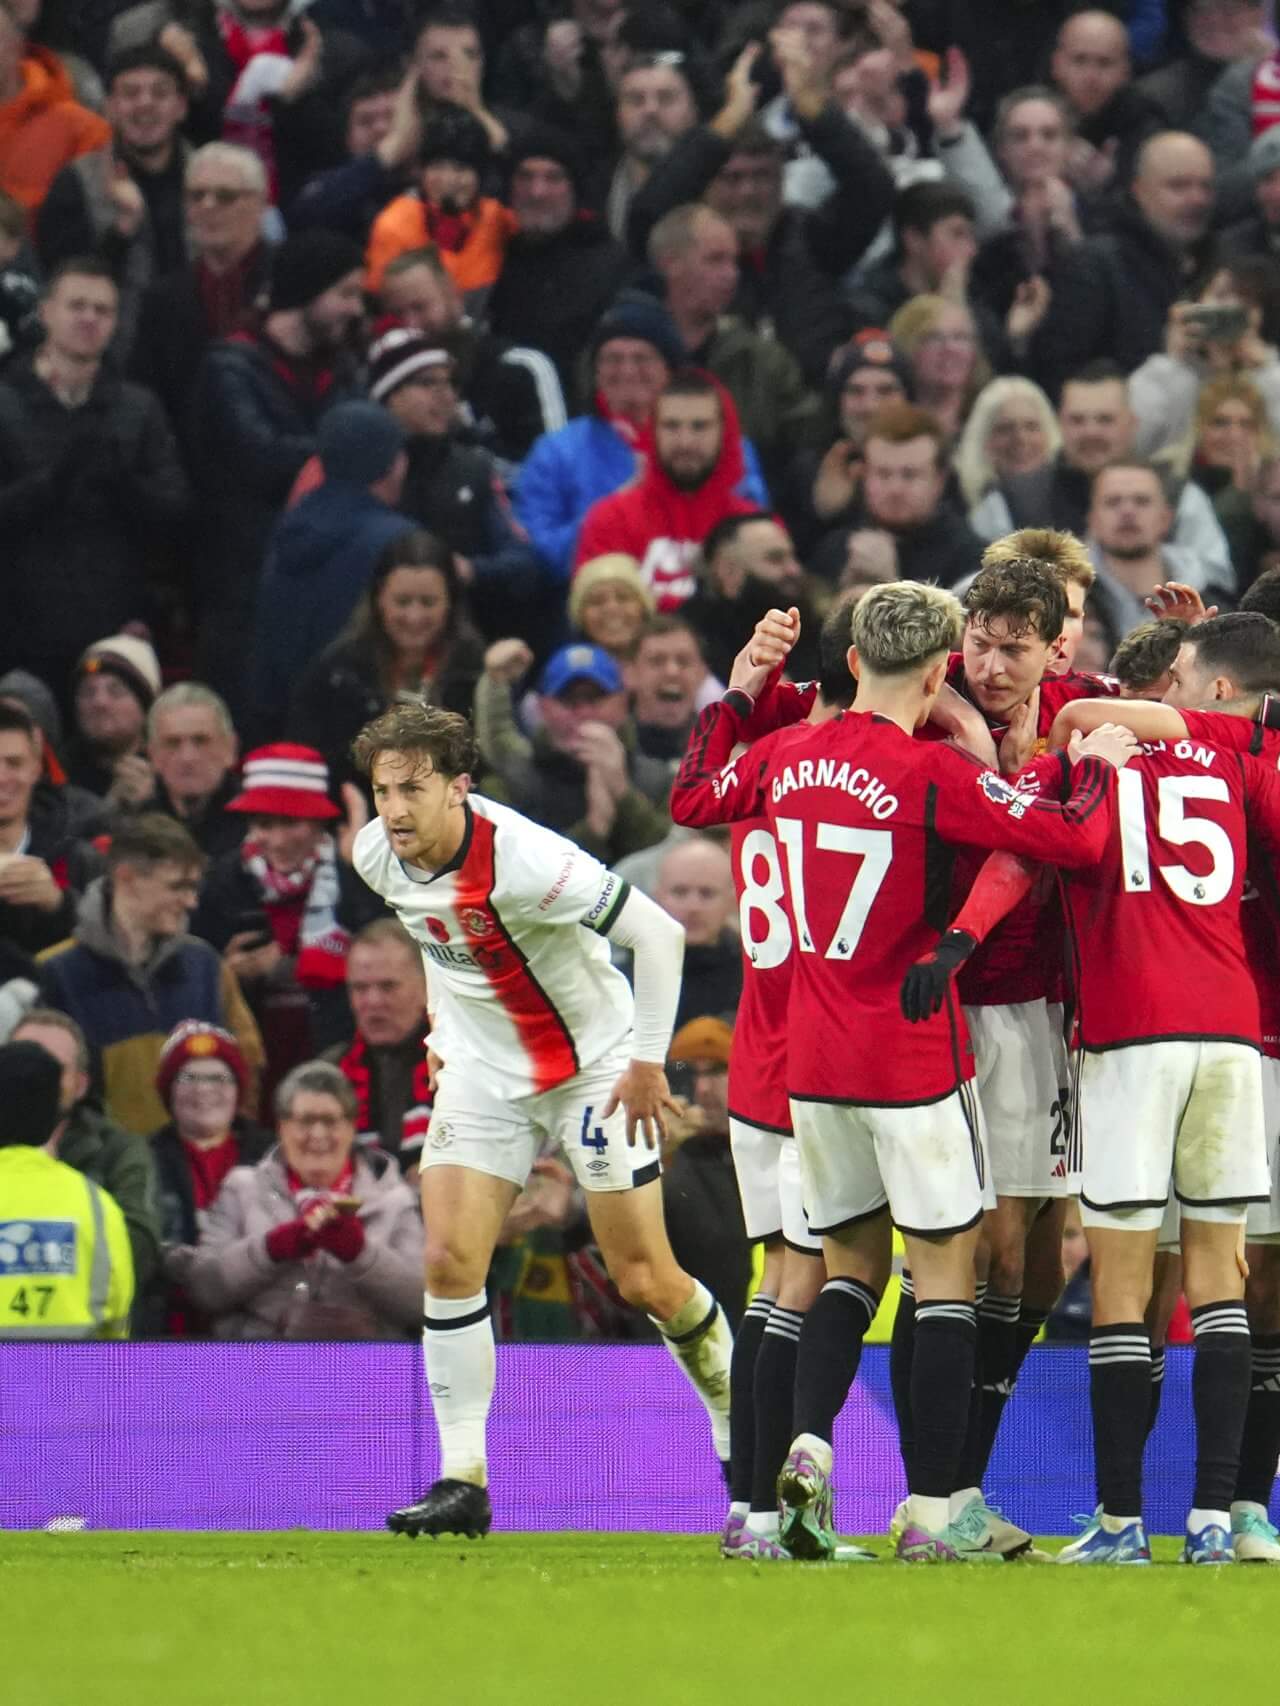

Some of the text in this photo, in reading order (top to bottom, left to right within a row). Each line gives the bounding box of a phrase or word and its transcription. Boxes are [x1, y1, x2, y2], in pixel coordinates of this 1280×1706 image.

[772, 758, 898, 820] GARNACHO
[1117, 767, 1235, 906] 15
[775, 817, 893, 961] 17
[581, 1106, 609, 1147] 4
[9, 1286, 55, 1317] 47
